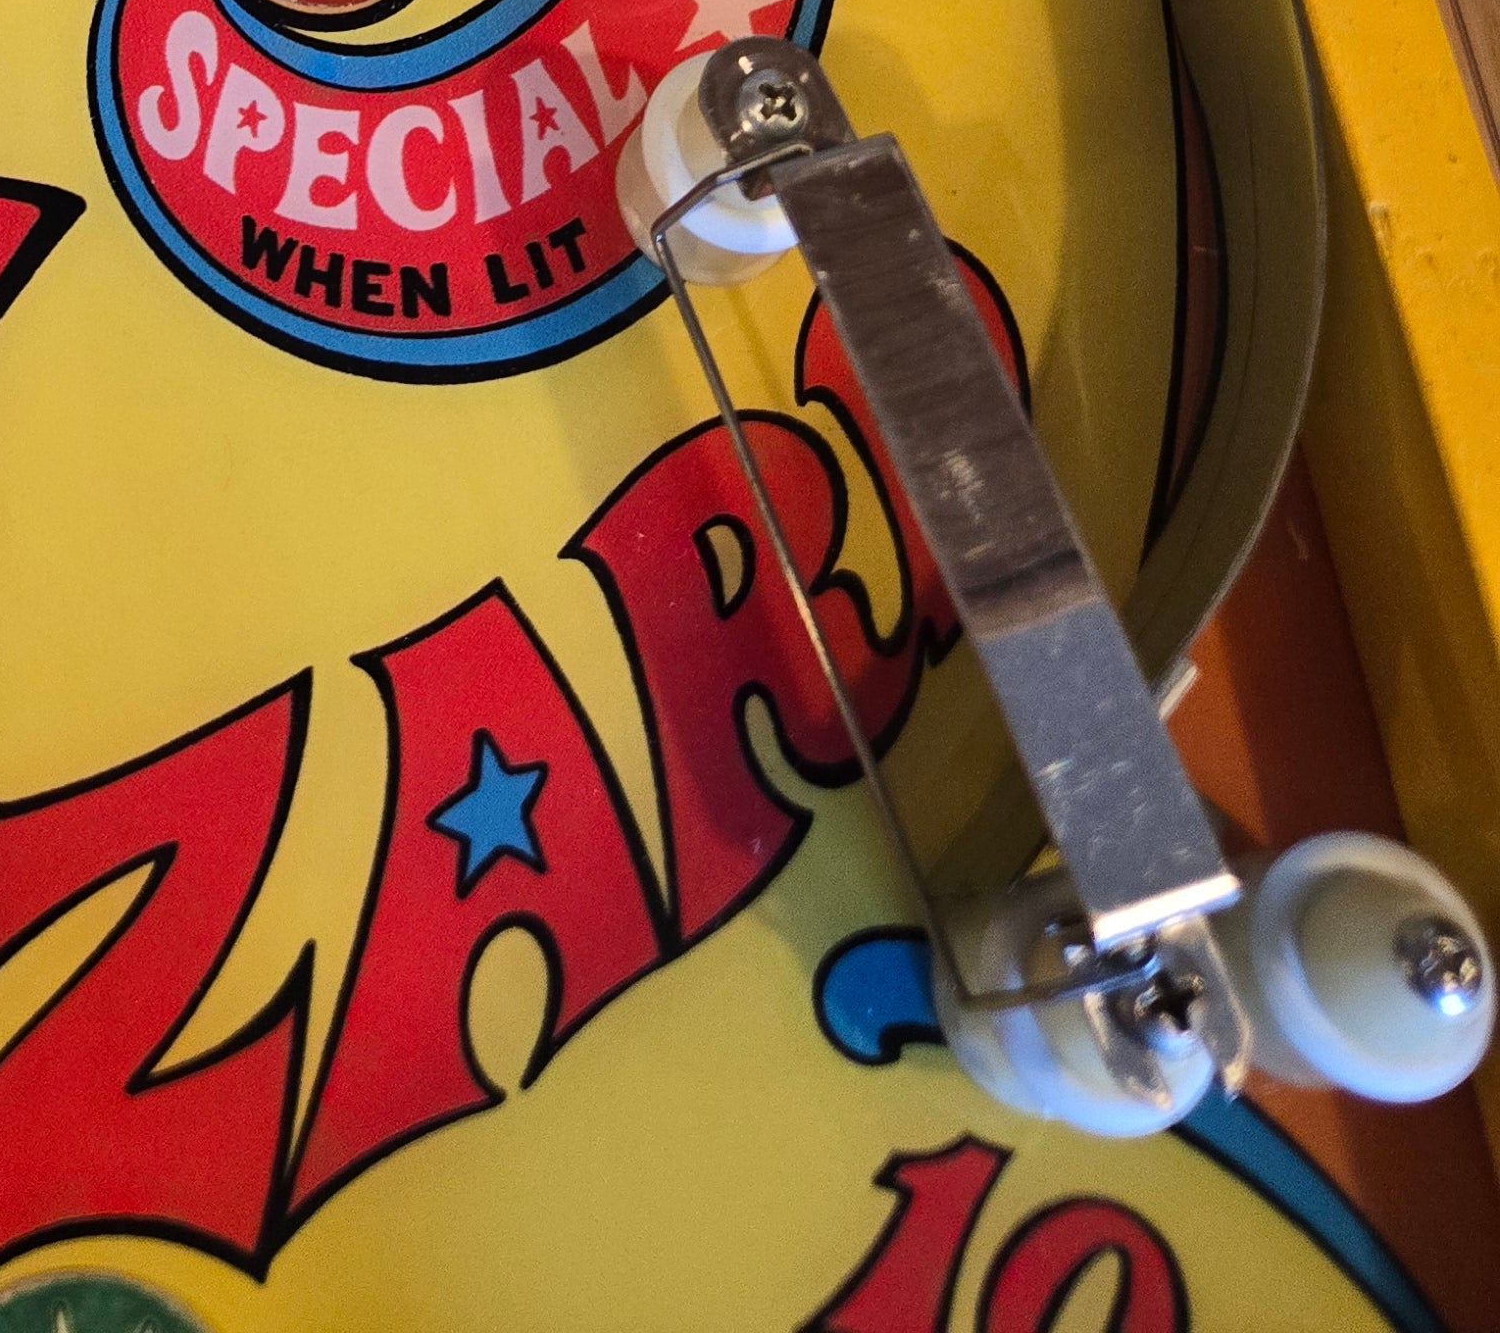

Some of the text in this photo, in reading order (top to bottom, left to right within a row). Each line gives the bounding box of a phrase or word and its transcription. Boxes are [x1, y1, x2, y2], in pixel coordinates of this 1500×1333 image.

[136, 9, 650, 232] SPECIAL
[239, 214, 588, 318] WHEN LIT
